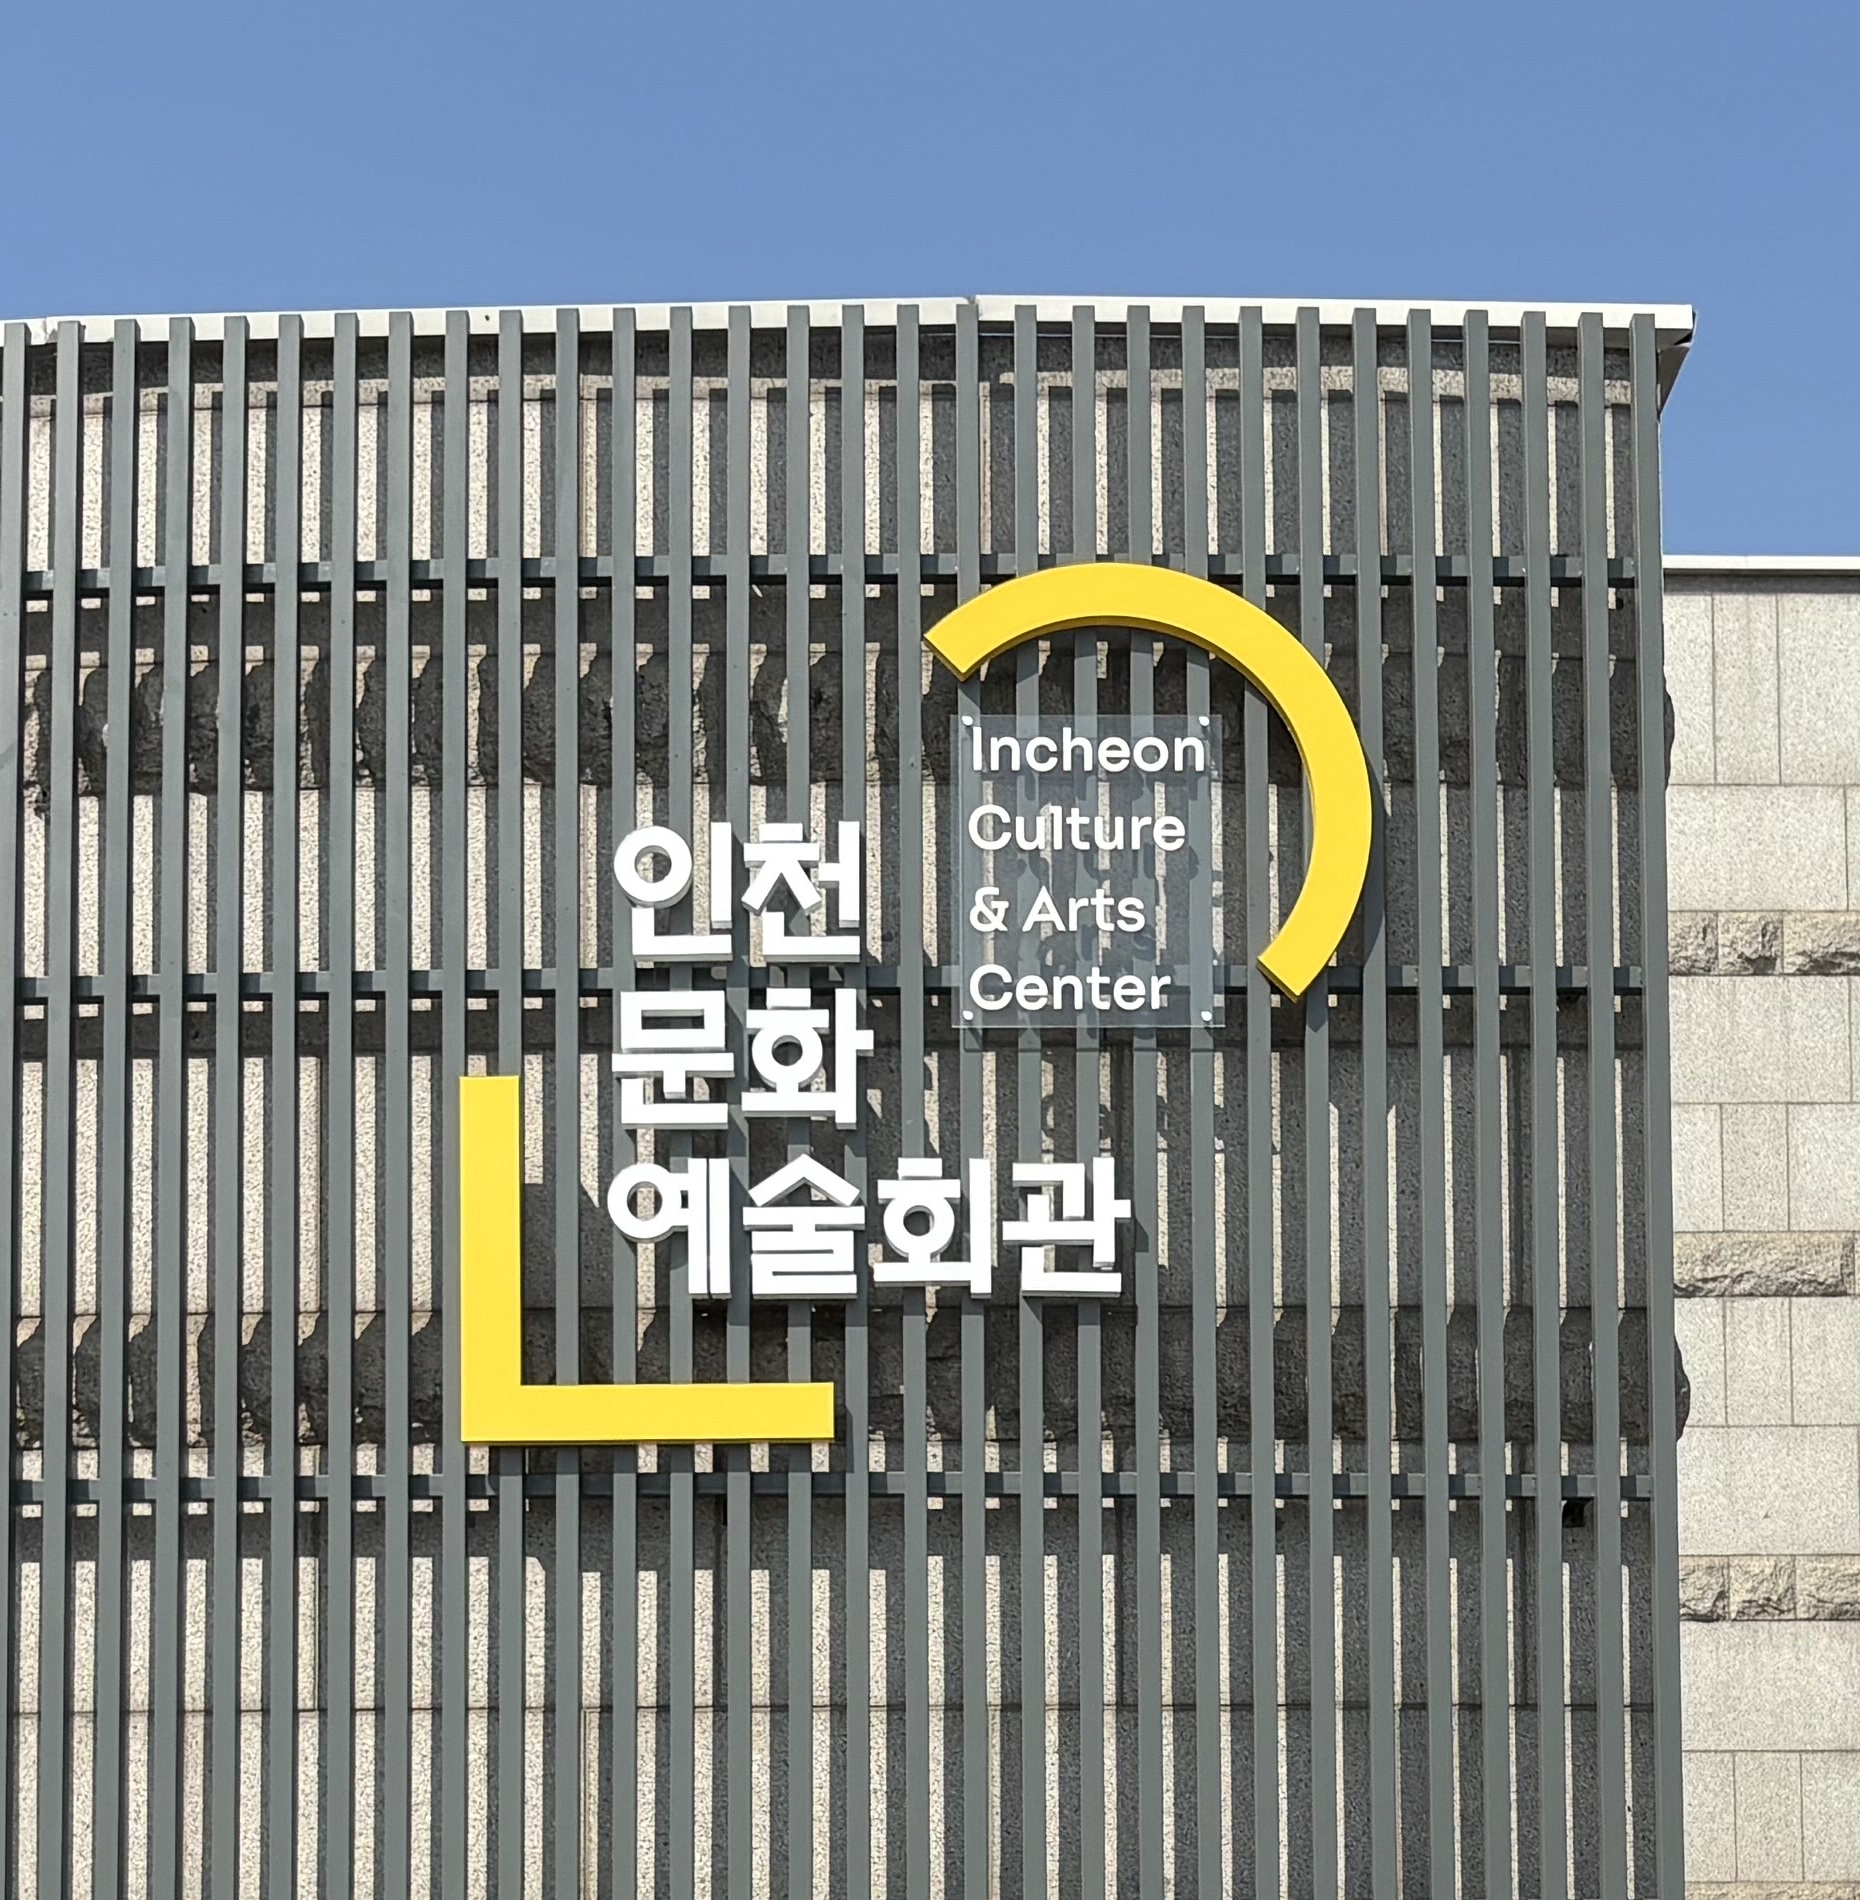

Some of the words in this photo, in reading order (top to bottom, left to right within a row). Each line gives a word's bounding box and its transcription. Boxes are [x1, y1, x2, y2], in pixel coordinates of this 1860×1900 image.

[970, 726, 1206, 774] Incheon
[968, 804, 1186, 852] Culture
[613, 820, 861, 963] 인천
[970, 890, 1007, 932] &
[1023, 888, 1146, 932] Arts
[969, 963, 1172, 1013] Center
[611, 988, 874, 1130] 문화
[606, 1155, 1132, 1299] 예술회관
